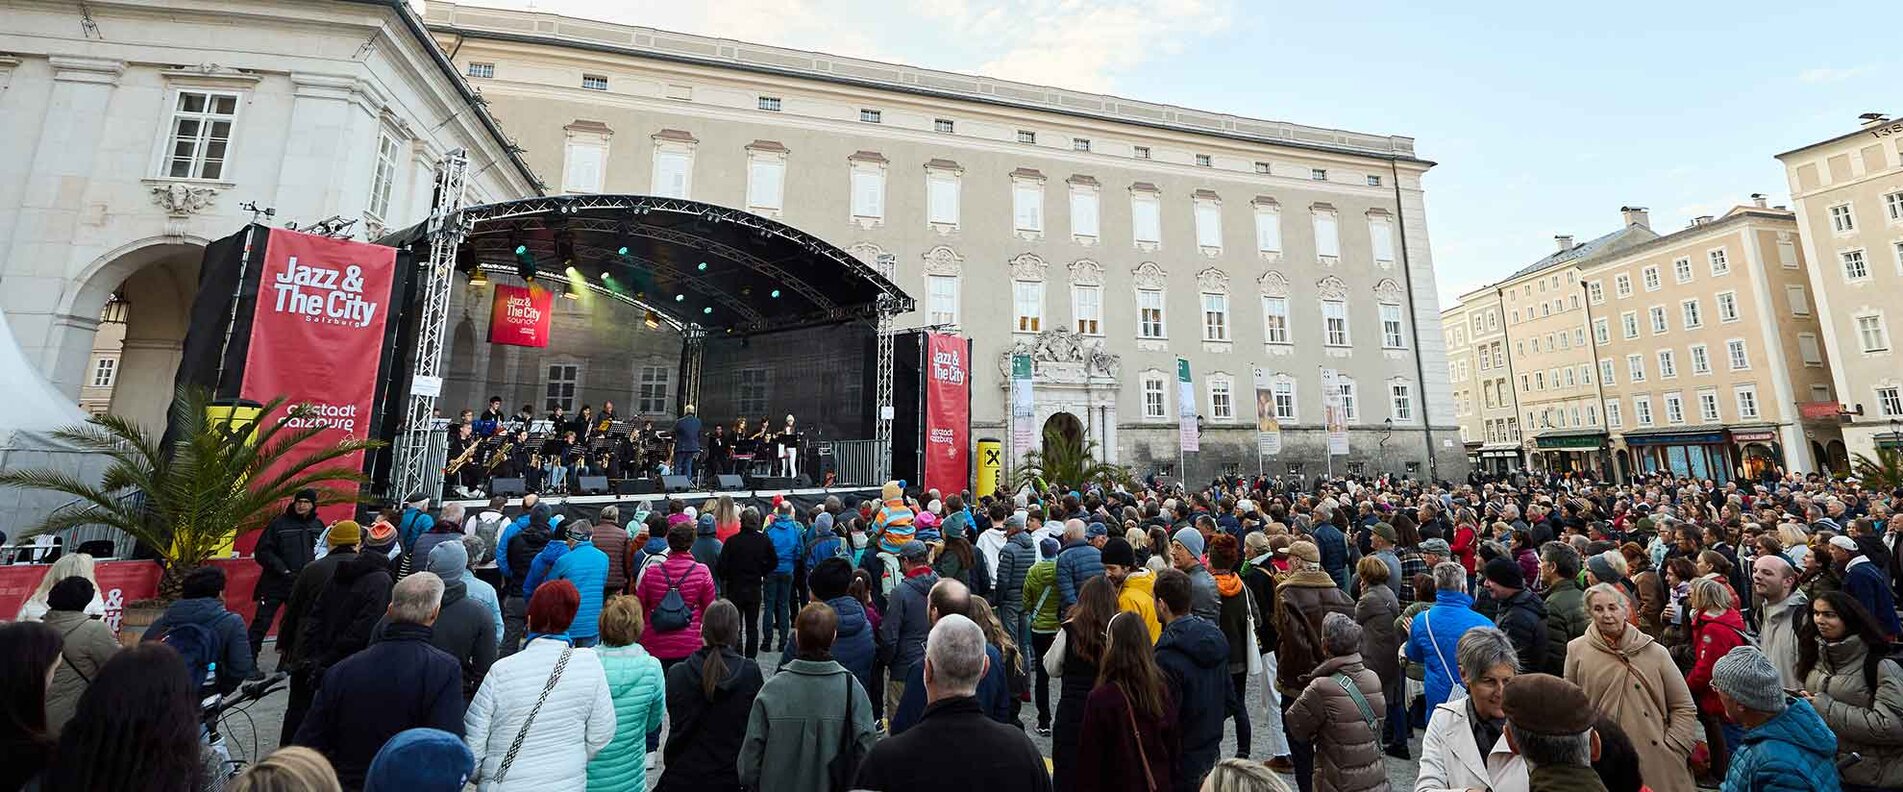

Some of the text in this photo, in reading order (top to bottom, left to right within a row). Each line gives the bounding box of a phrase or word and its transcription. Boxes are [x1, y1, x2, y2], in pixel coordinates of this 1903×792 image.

[276, 256, 364, 293] Jazz &
[274, 282, 378, 327] The City
[506, 294, 532, 307] Jazz &
[305, 315, 360, 328] Salzburg
[507, 304, 541, 322] The City
[933, 346, 960, 366] Jazz &
[933, 362, 965, 385] The City
[105, 588, 123, 610] &
